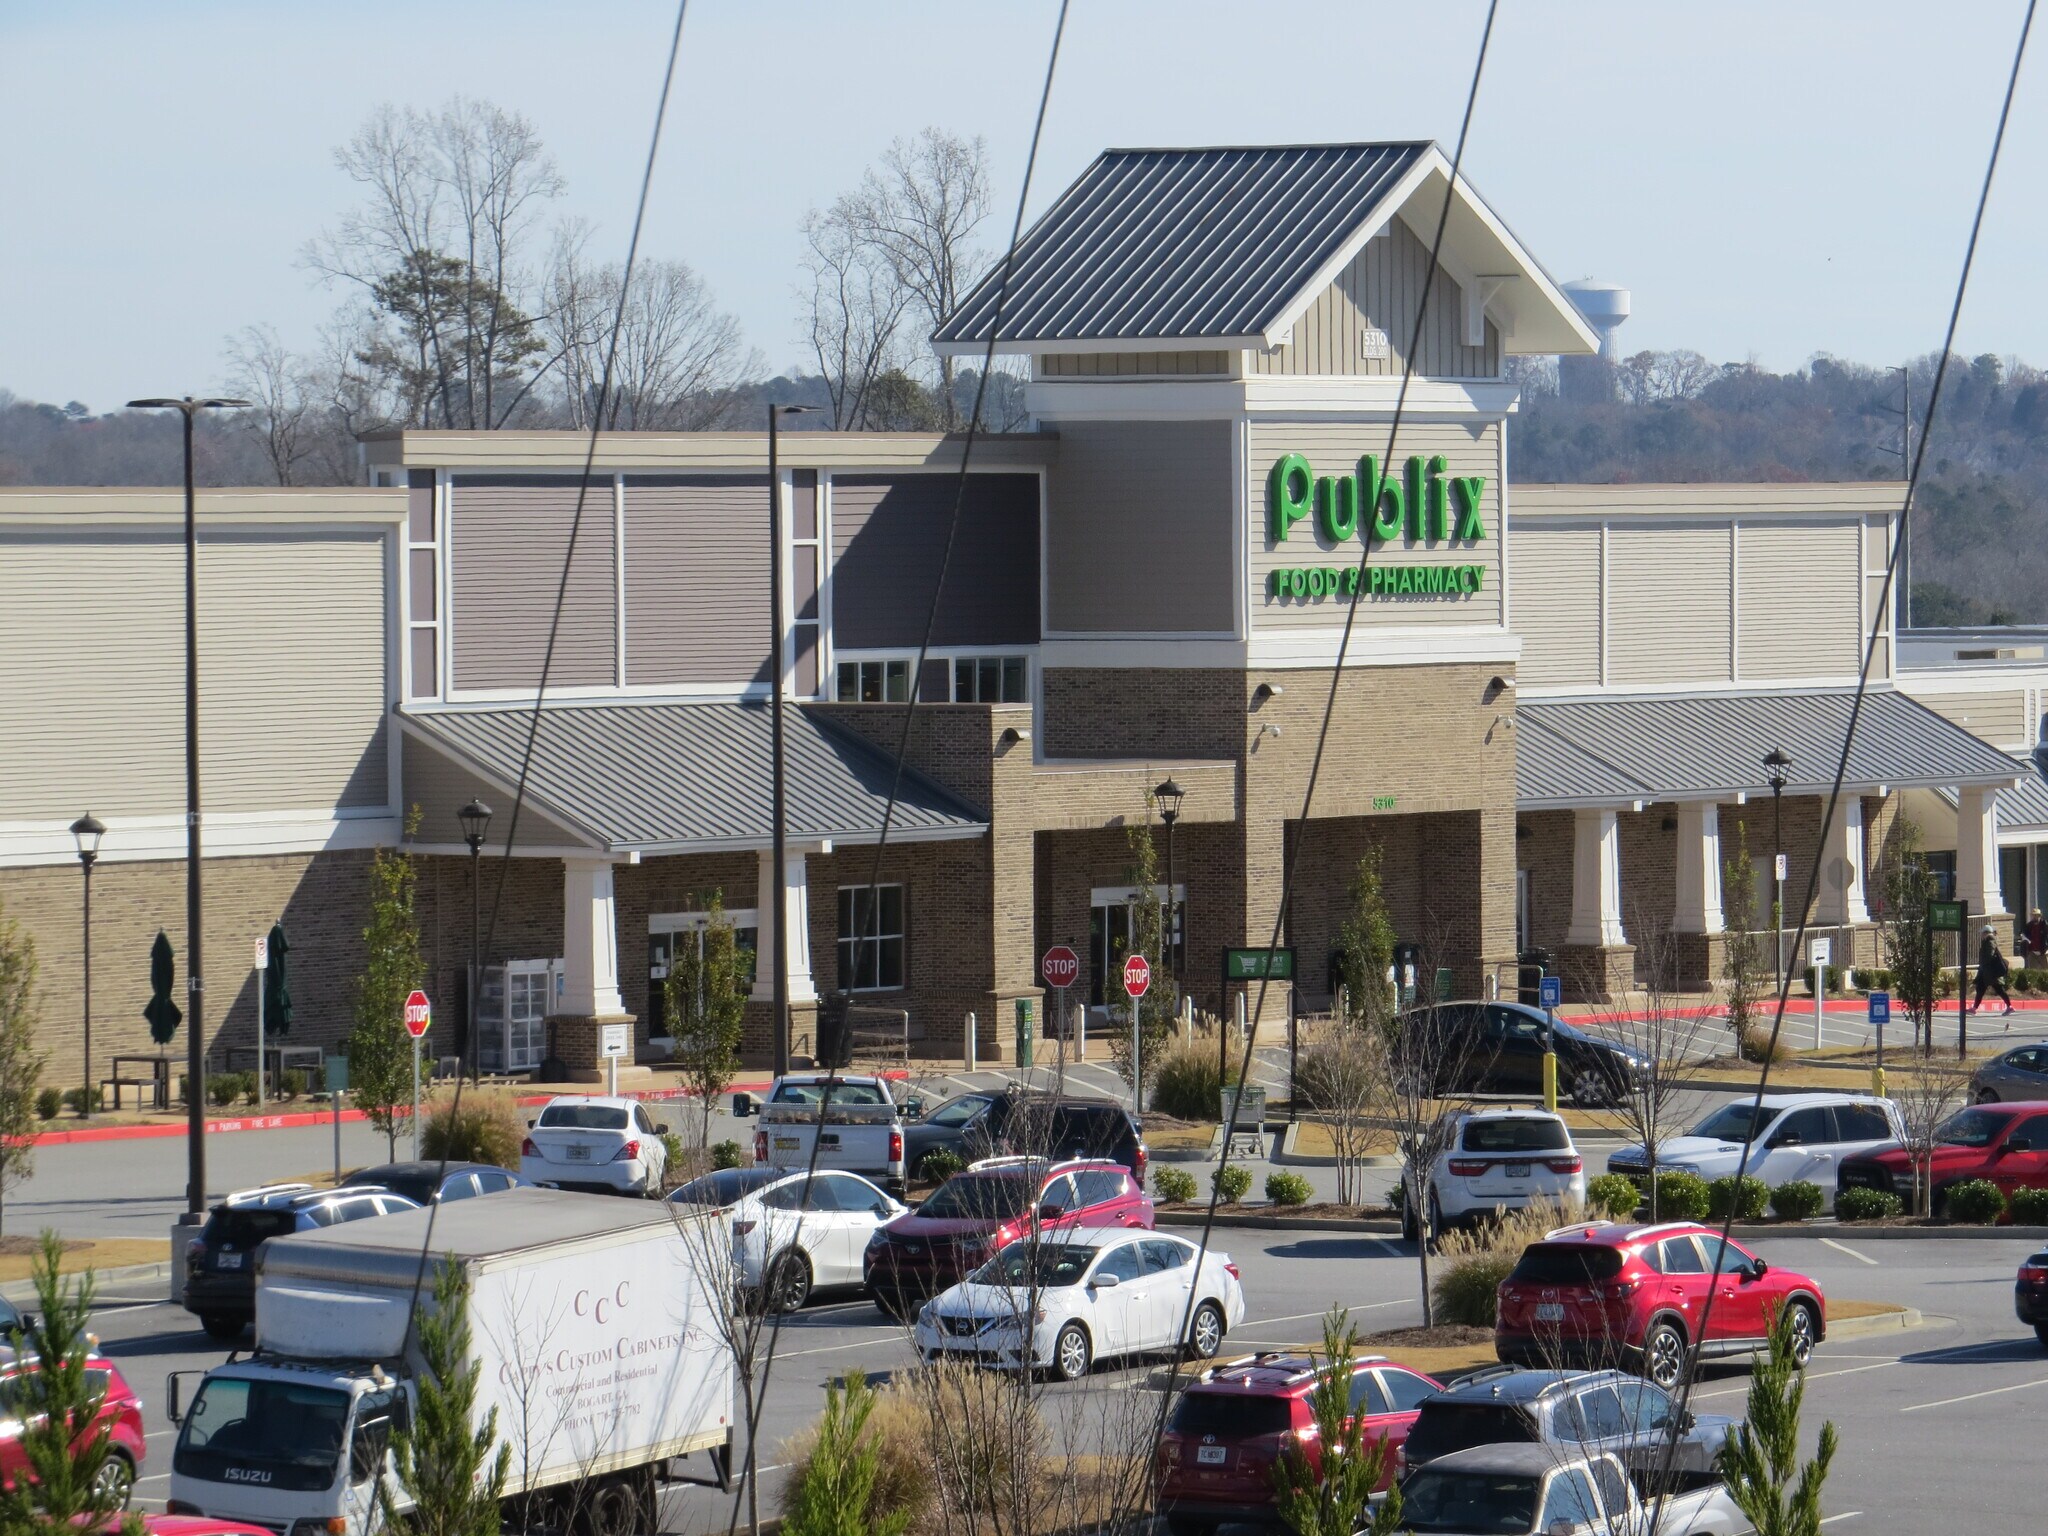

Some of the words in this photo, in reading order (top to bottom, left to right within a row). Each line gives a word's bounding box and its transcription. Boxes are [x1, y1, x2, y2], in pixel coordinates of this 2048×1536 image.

[1364, 331, 1388, 346] 5310
[1270, 453, 1486, 542] Publix
[1272, 567, 1340, 597] FOOD
[1341, 566, 1360, 595] &
[1366, 565, 1486, 594] PHARMACY
[1045, 959, 1076, 975] STOP
[1126, 969, 1148, 984] STOP
[407, 1004, 428, 1022] STOP
[252, 1118, 264, 1128] FIRE
[556, 1347, 613, 1372] CUSTOM
[596, 1374, 612, 1387] and
[614, 1364, 658, 1383] Residential
[224, 1467, 272, 1482] ISUZU
